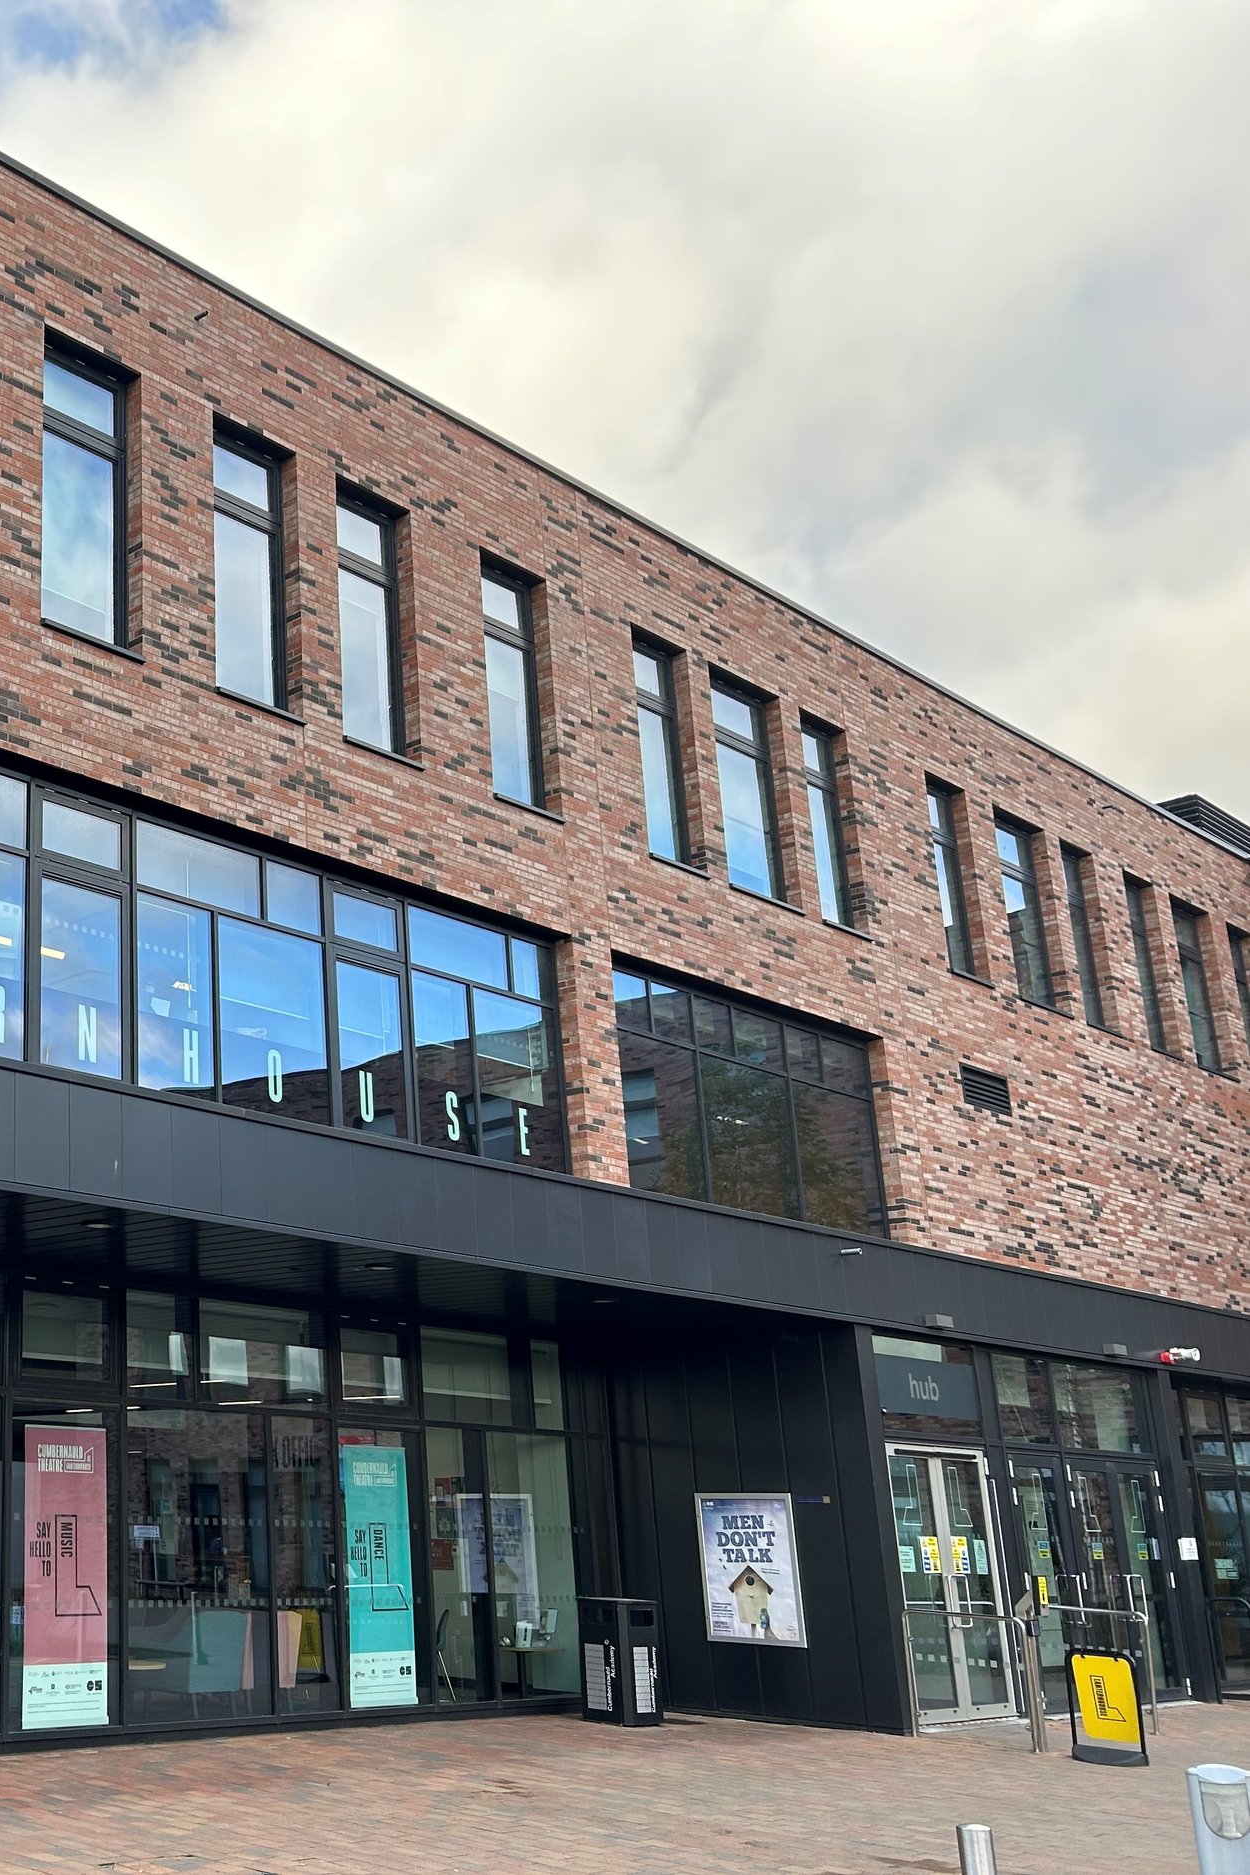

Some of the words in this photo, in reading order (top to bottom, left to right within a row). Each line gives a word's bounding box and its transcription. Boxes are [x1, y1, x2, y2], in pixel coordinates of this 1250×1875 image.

[908, 1373, 939, 1401] hub
[37, 1443, 84, 1459] CUMBERNAULD
[37, 1458, 64, 1473] THEATRE
[36, 1521, 51, 1539] SAY
[721, 1514, 765, 1530] MEN
[60, 1522, 73, 1558] MUSIC
[354, 1529, 366, 1544] SAY
[373, 1529, 385, 1560] DANCE
[715, 1530, 776, 1547] DON'T
[29, 1541, 51, 1558] HELLO
[350, 1546, 367, 1561] HELLO
[722, 1548, 773, 1563] TALK
[41, 1560, 51, 1577] TO
[359, 1562, 368, 1577] TO
